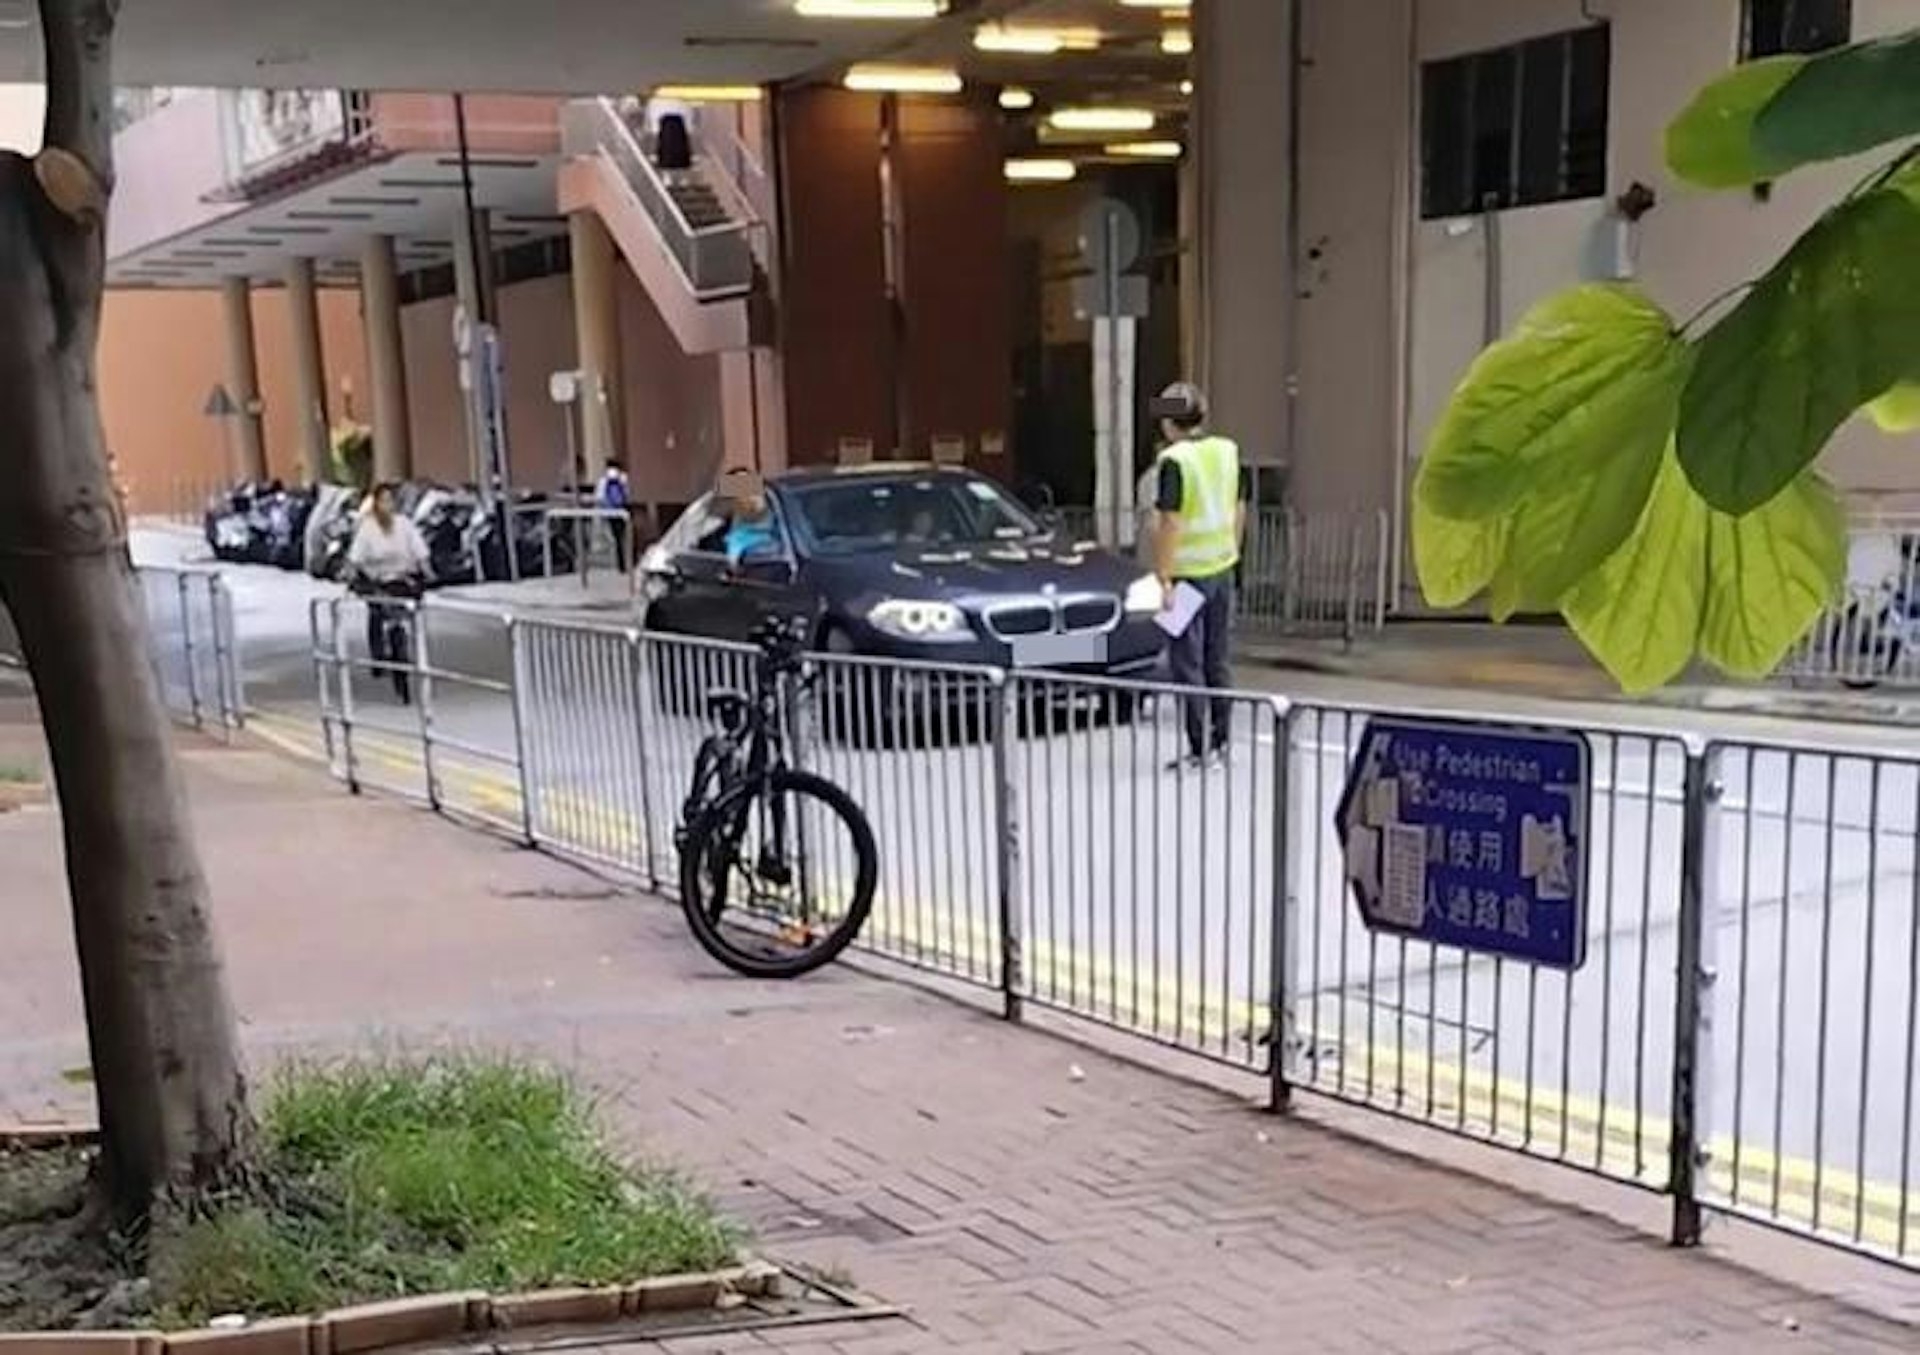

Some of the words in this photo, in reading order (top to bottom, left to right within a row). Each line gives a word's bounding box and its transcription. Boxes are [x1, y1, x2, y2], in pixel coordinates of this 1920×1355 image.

[1393, 739, 1430, 771] Use
[1435, 744, 1540, 782] Pedestrian
[1426, 779, 1507, 823] Crossing
